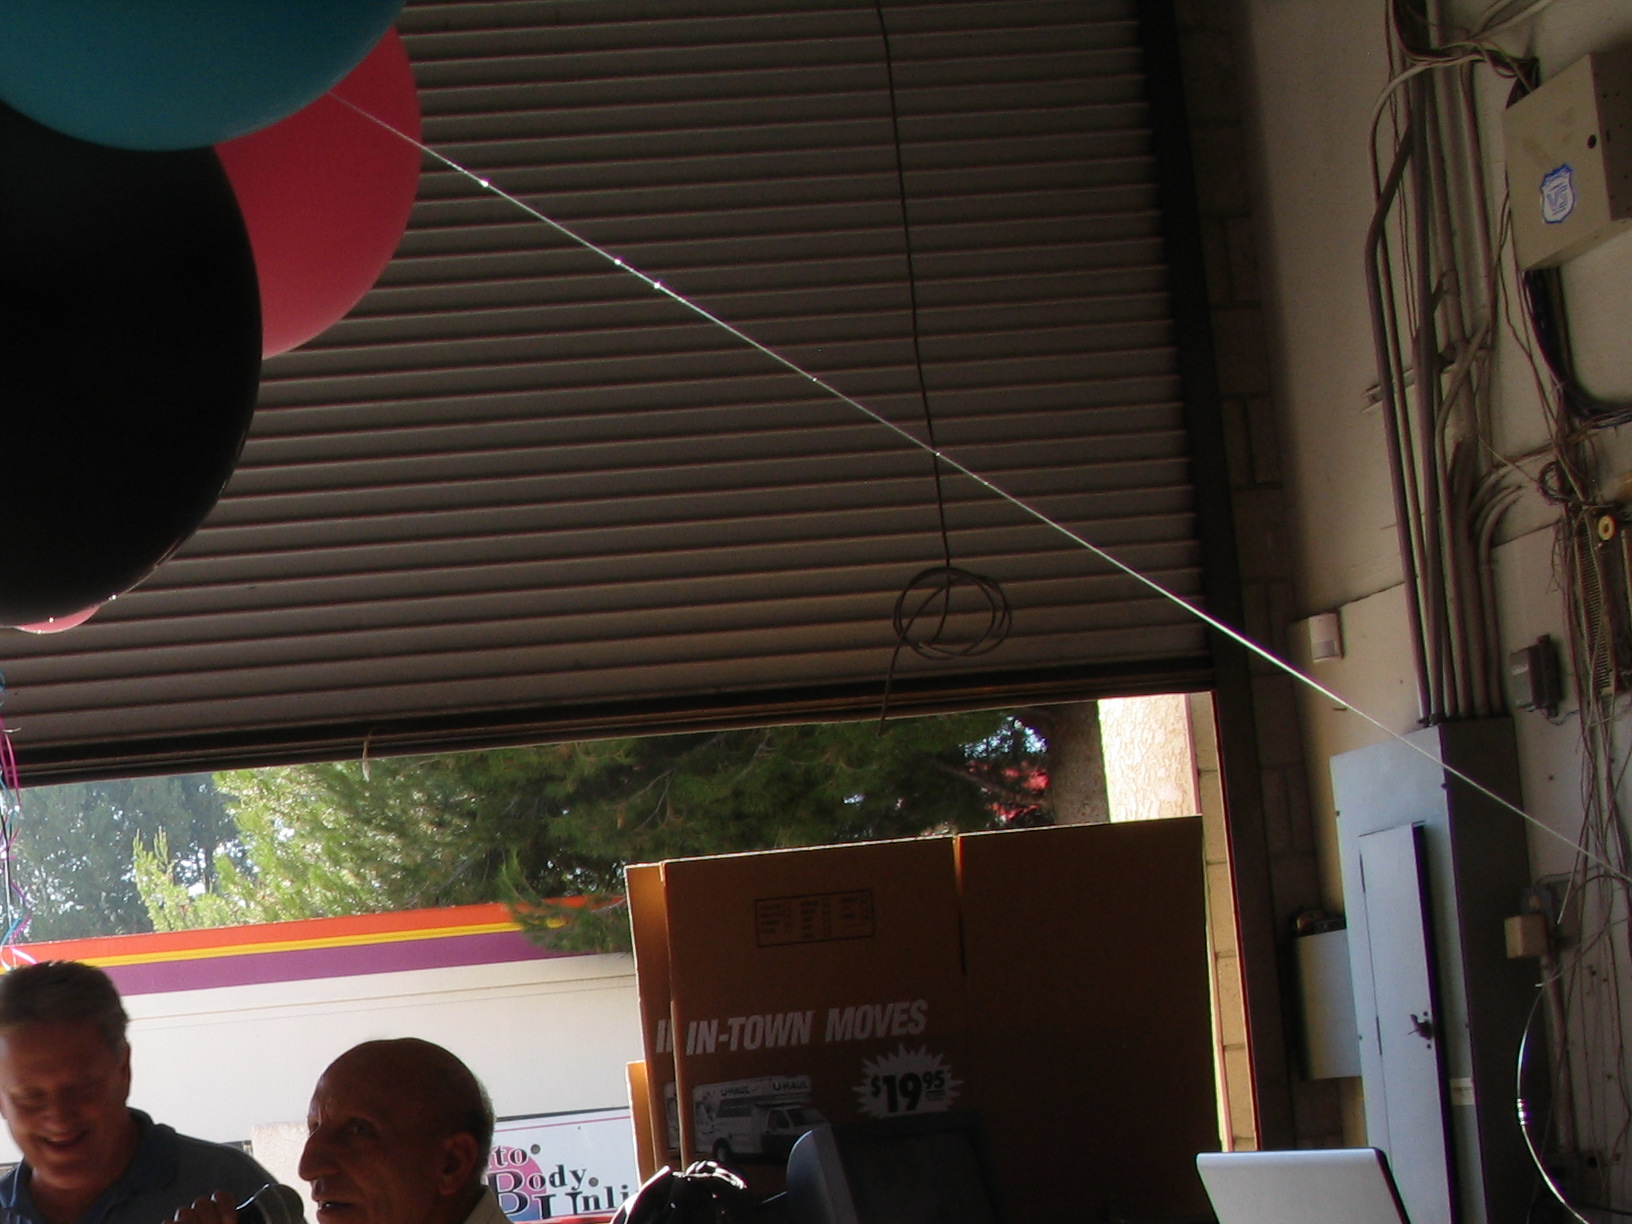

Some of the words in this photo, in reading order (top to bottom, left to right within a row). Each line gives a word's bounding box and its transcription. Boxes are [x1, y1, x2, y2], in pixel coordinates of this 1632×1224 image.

[685, 1010, 816, 1056] IN-TOWN
[824, 998, 929, 1043] MOVES
[487, 1164, 587, 1215] Body
